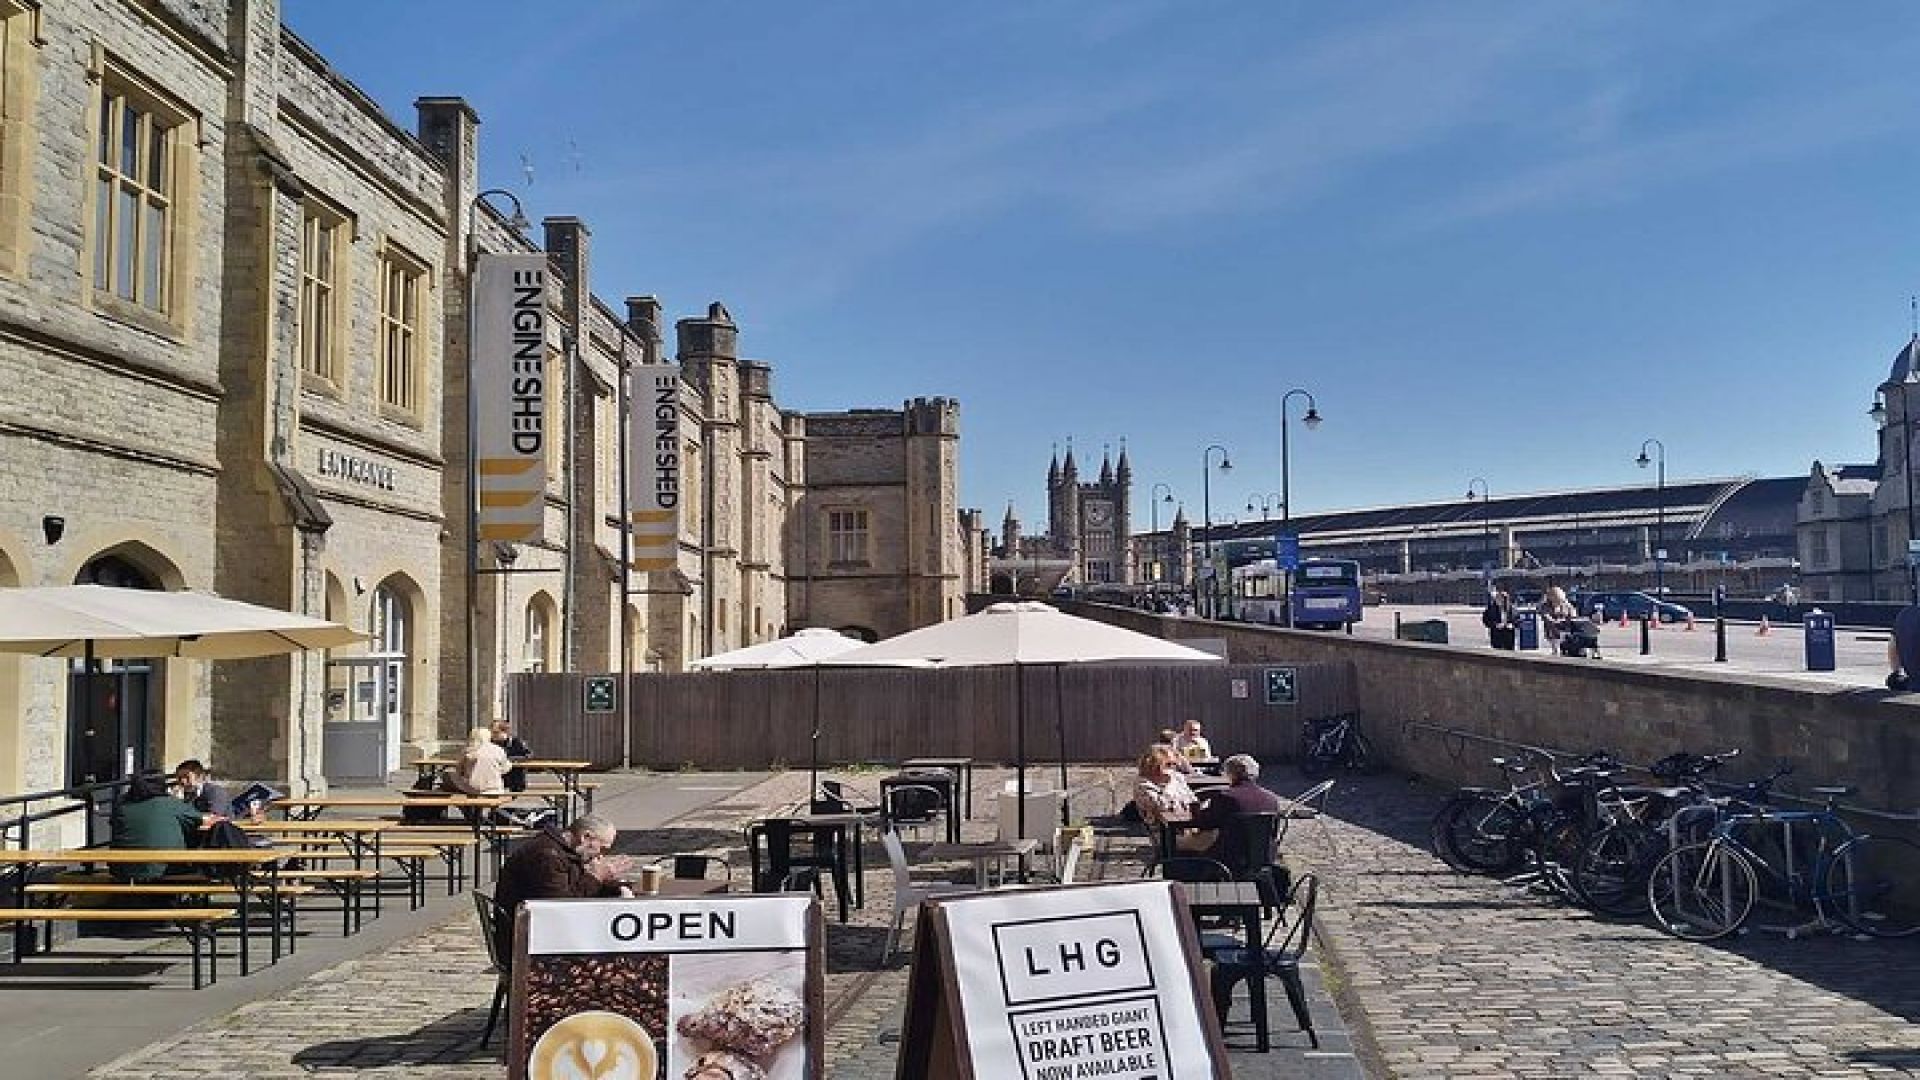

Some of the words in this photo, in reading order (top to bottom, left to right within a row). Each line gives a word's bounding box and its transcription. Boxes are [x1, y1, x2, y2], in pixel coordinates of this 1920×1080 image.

[512, 270, 542, 455] ENGINESHED
[655, 376, 678, 509] ENGINESHED
[318, 449, 394, 491] ENTRANCE
[610, 911, 736, 941] OPEN
[1021, 1020, 1051, 1037] LEFT
[1055, 1013, 1110, 1032] HANDED
[1111, 1008, 1150, 1025] GIANT
[1029, 1034, 1094, 1063] DRAFT
[1100, 1027, 1153, 1053] BEER
[1036, 1063, 1073, 1080] NOW
[1076, 1053, 1157, 1078] AVAILABLE
